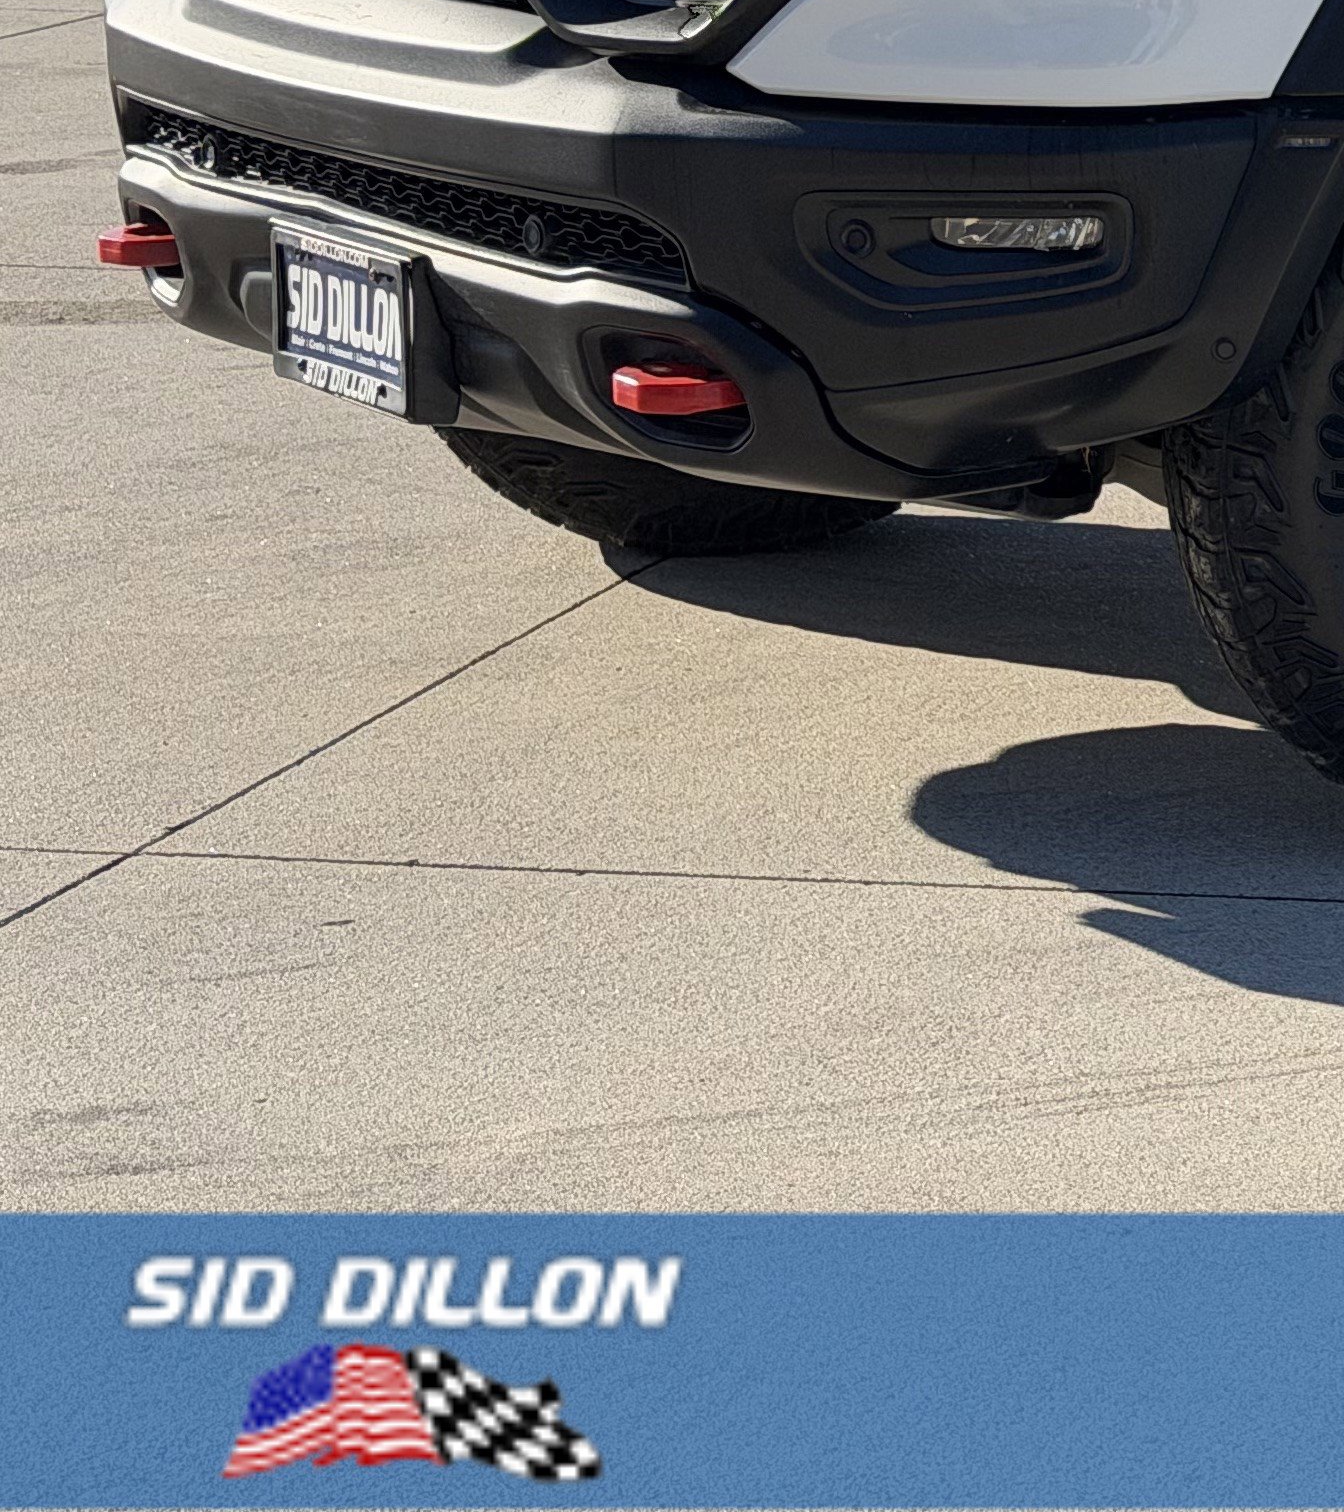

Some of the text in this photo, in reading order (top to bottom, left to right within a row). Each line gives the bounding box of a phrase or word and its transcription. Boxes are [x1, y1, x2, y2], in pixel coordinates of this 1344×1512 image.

[287, 263, 401, 362] SID DILLON
[303, 359, 380, 406] SID DILLON
